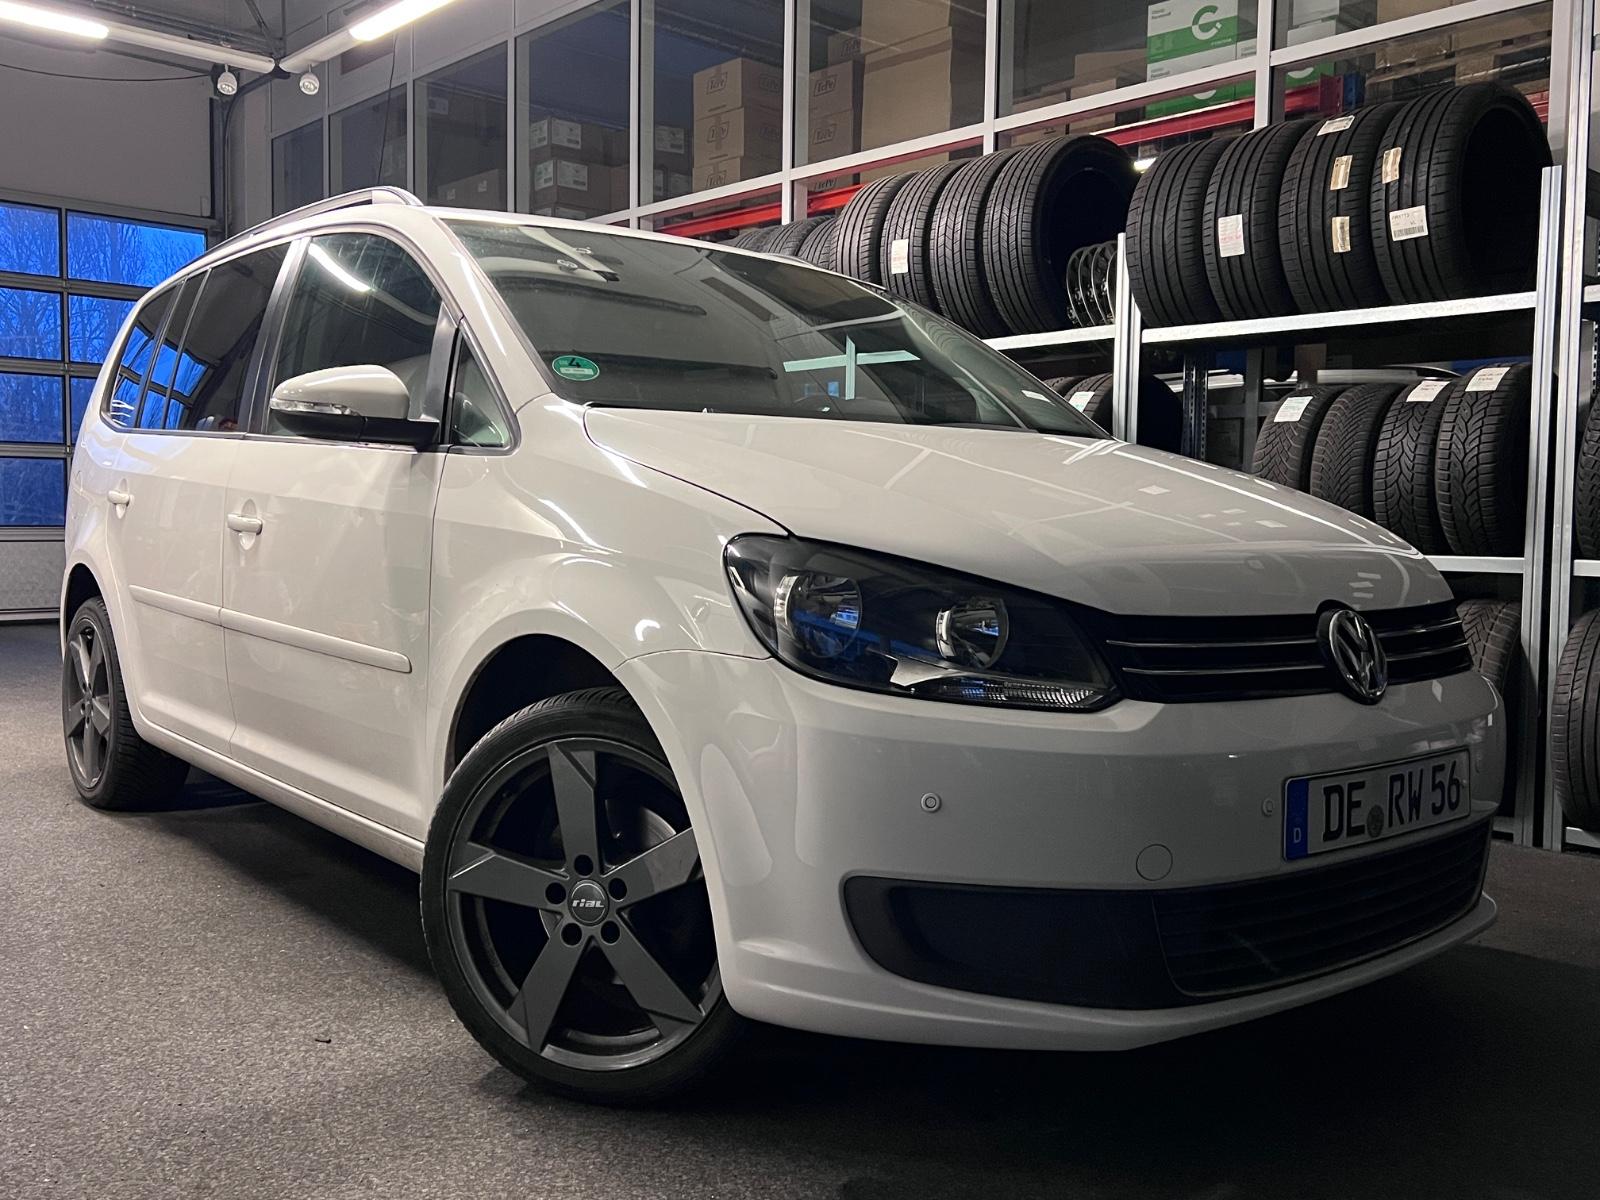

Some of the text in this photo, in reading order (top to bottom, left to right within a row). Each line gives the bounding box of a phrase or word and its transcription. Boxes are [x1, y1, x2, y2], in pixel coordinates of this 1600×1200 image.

[1322, 760, 1461, 842] DE RW 56
[1293, 827, 1302, 844] D
